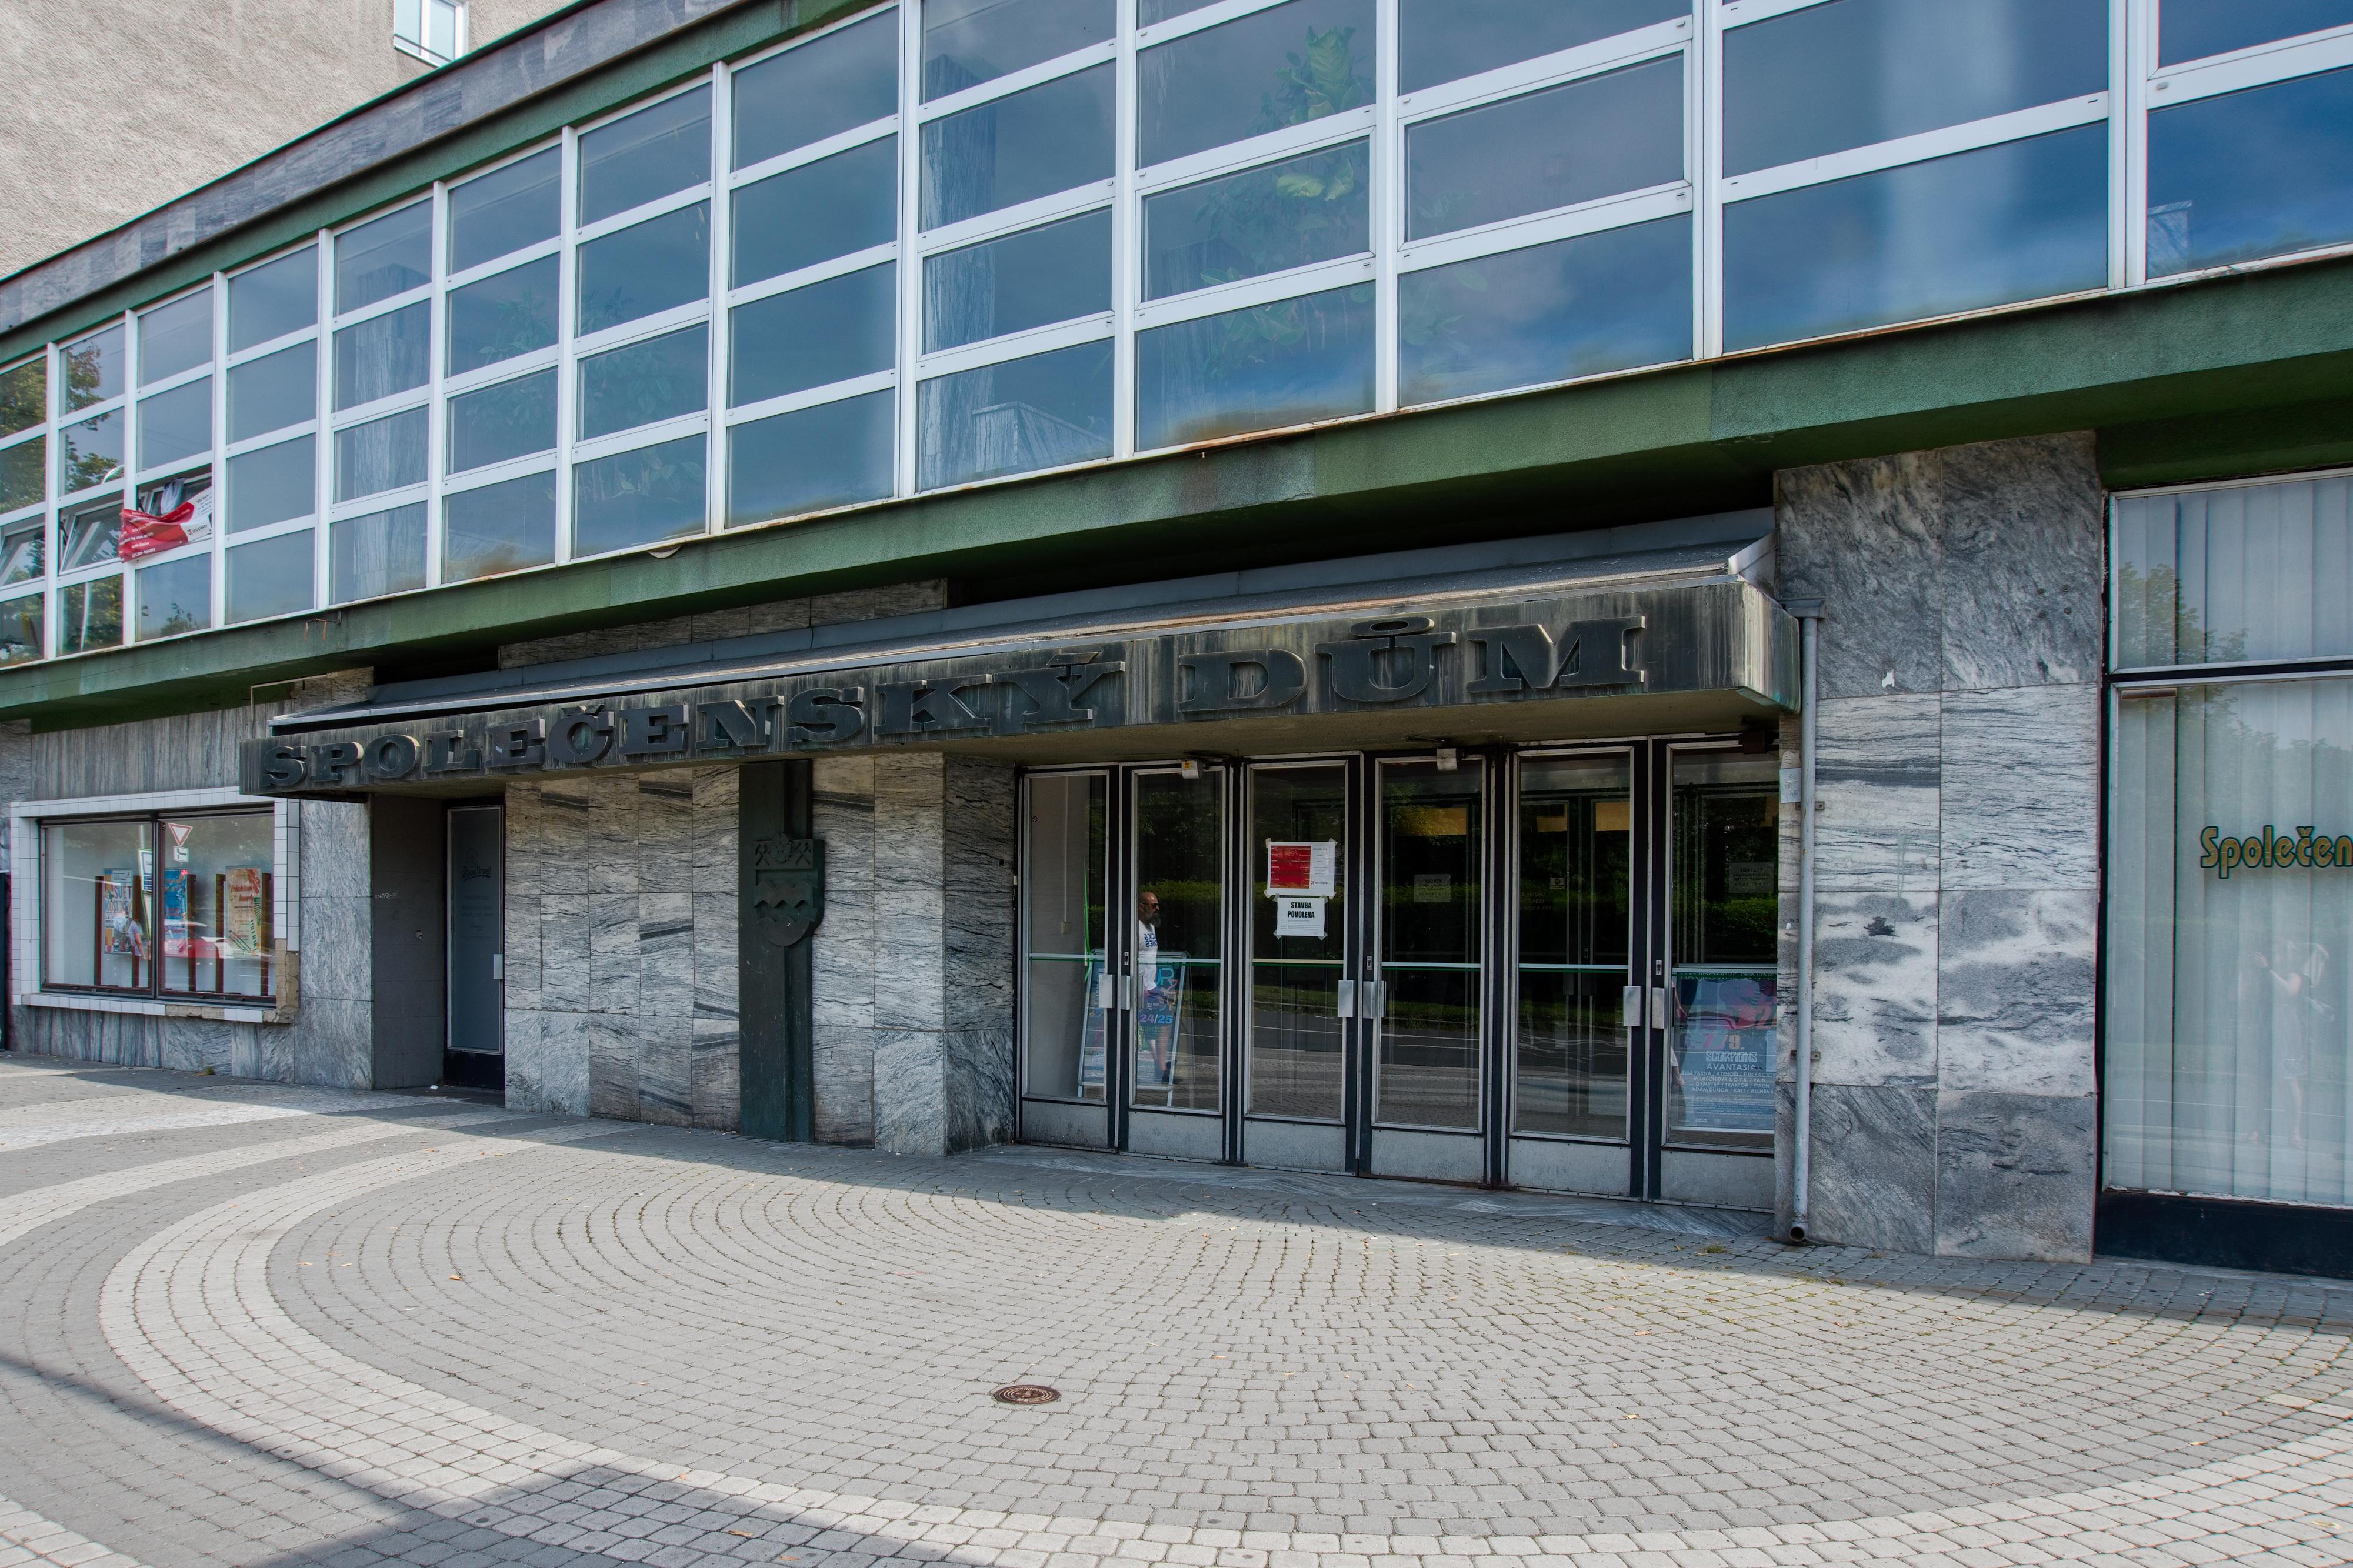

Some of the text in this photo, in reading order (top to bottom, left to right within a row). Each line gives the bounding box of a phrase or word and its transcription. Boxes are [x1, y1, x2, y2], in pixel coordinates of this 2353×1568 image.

[262, 616, 1646, 788] SPOLEČENSKÝ DŮM
[1139, 1013, 1172, 1025] 24/25
[1706, 1051, 1758, 1062] SCORPIONS
